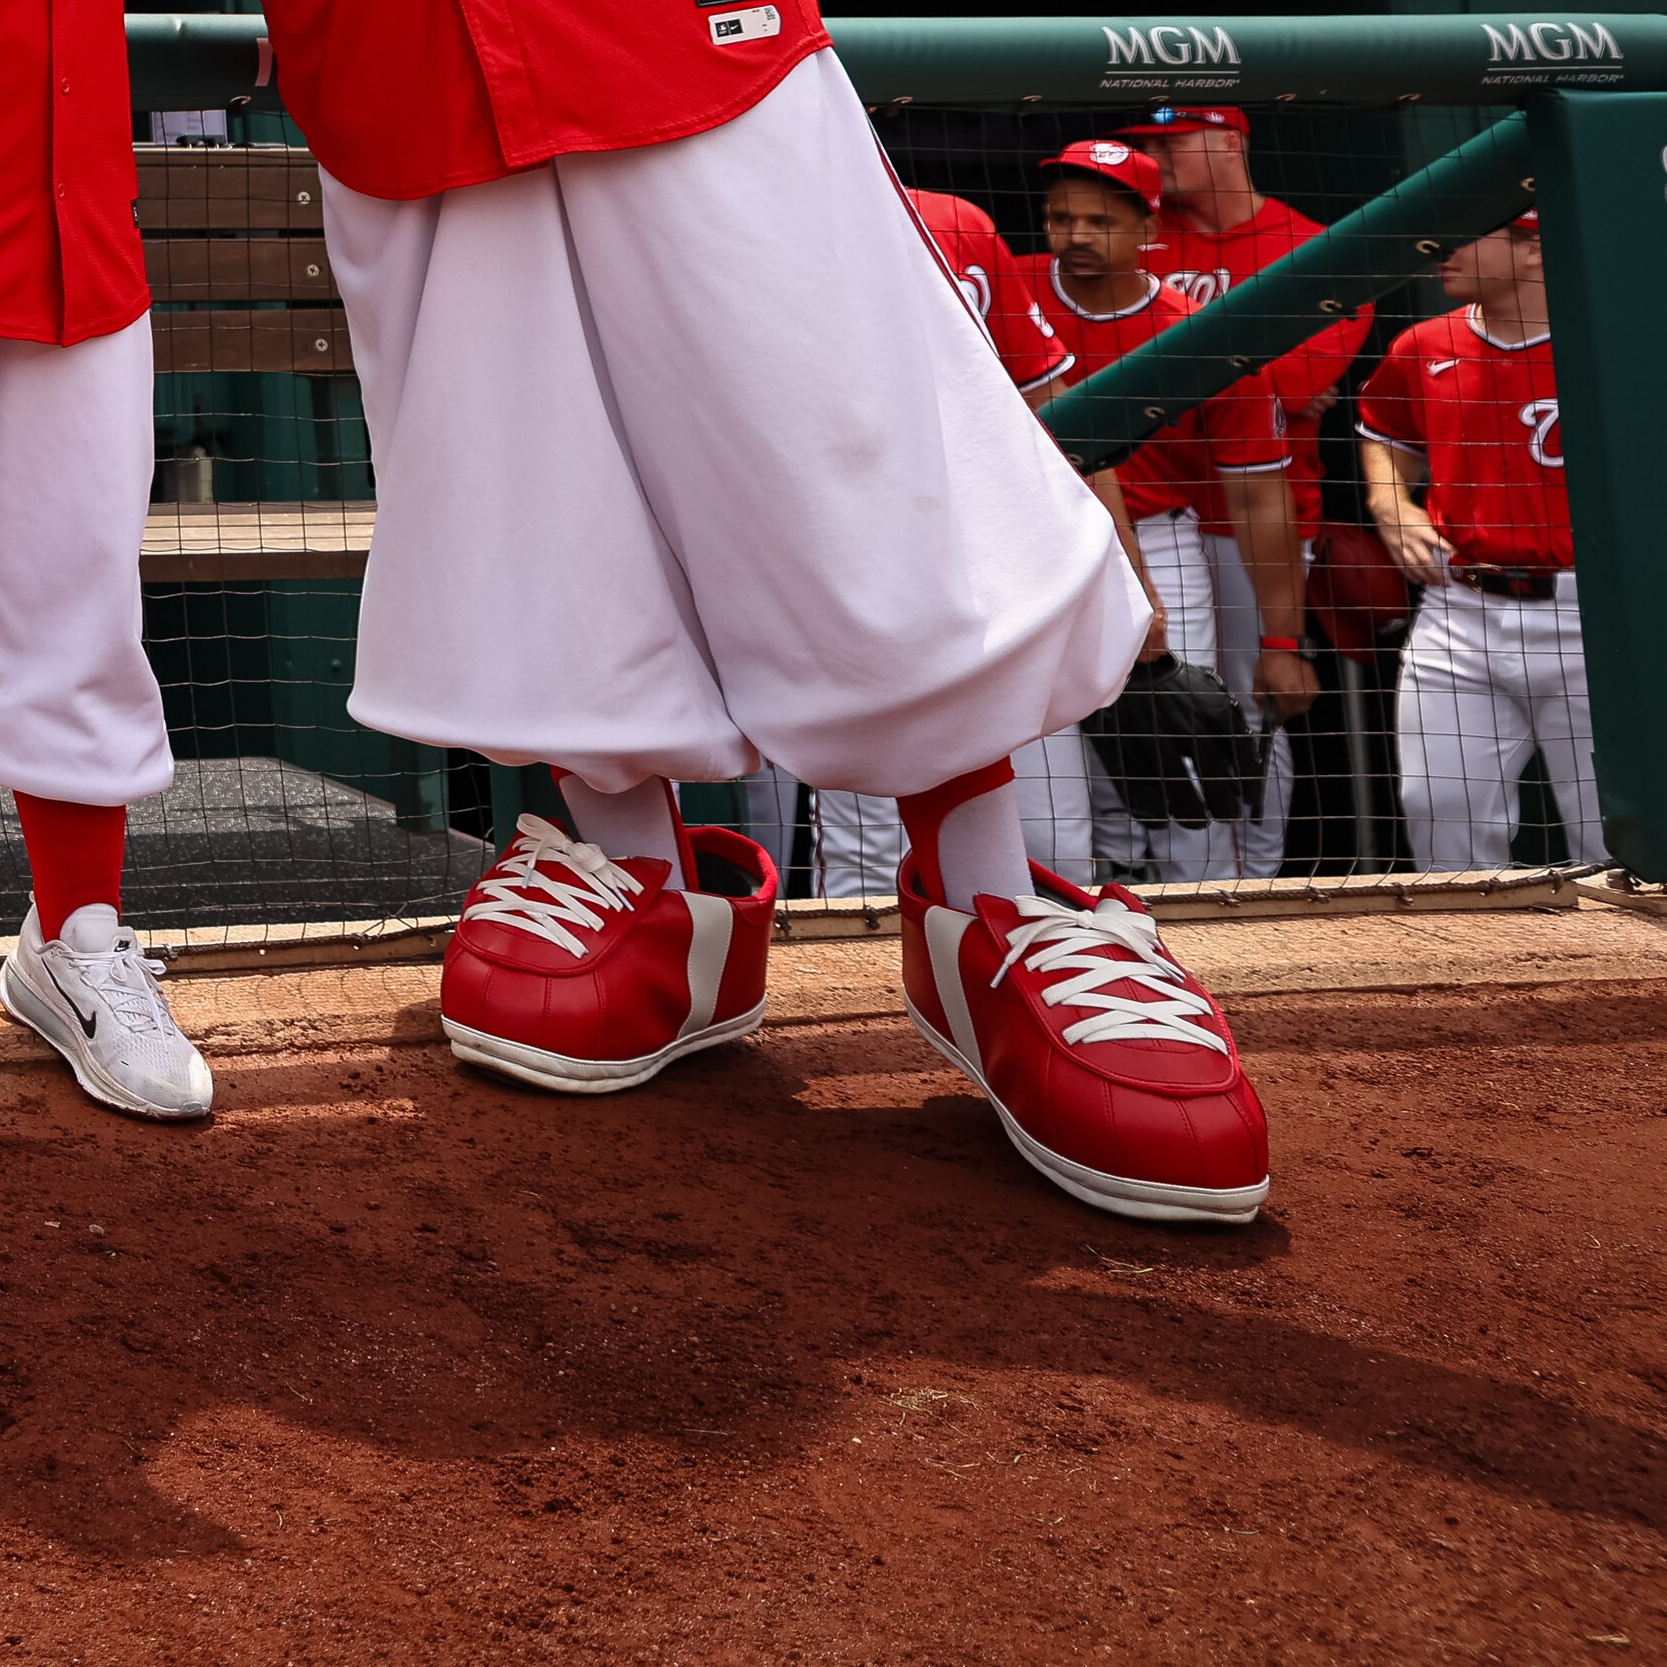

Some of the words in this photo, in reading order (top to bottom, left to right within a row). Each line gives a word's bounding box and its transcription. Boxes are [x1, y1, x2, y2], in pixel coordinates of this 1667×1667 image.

[1101, 26, 1241, 65] MGM
[1481, 22, 1624, 61] MGM
[1099, 78, 1170, 88] NATIONAL
[1481, 75, 1550, 85] NATIONAL
